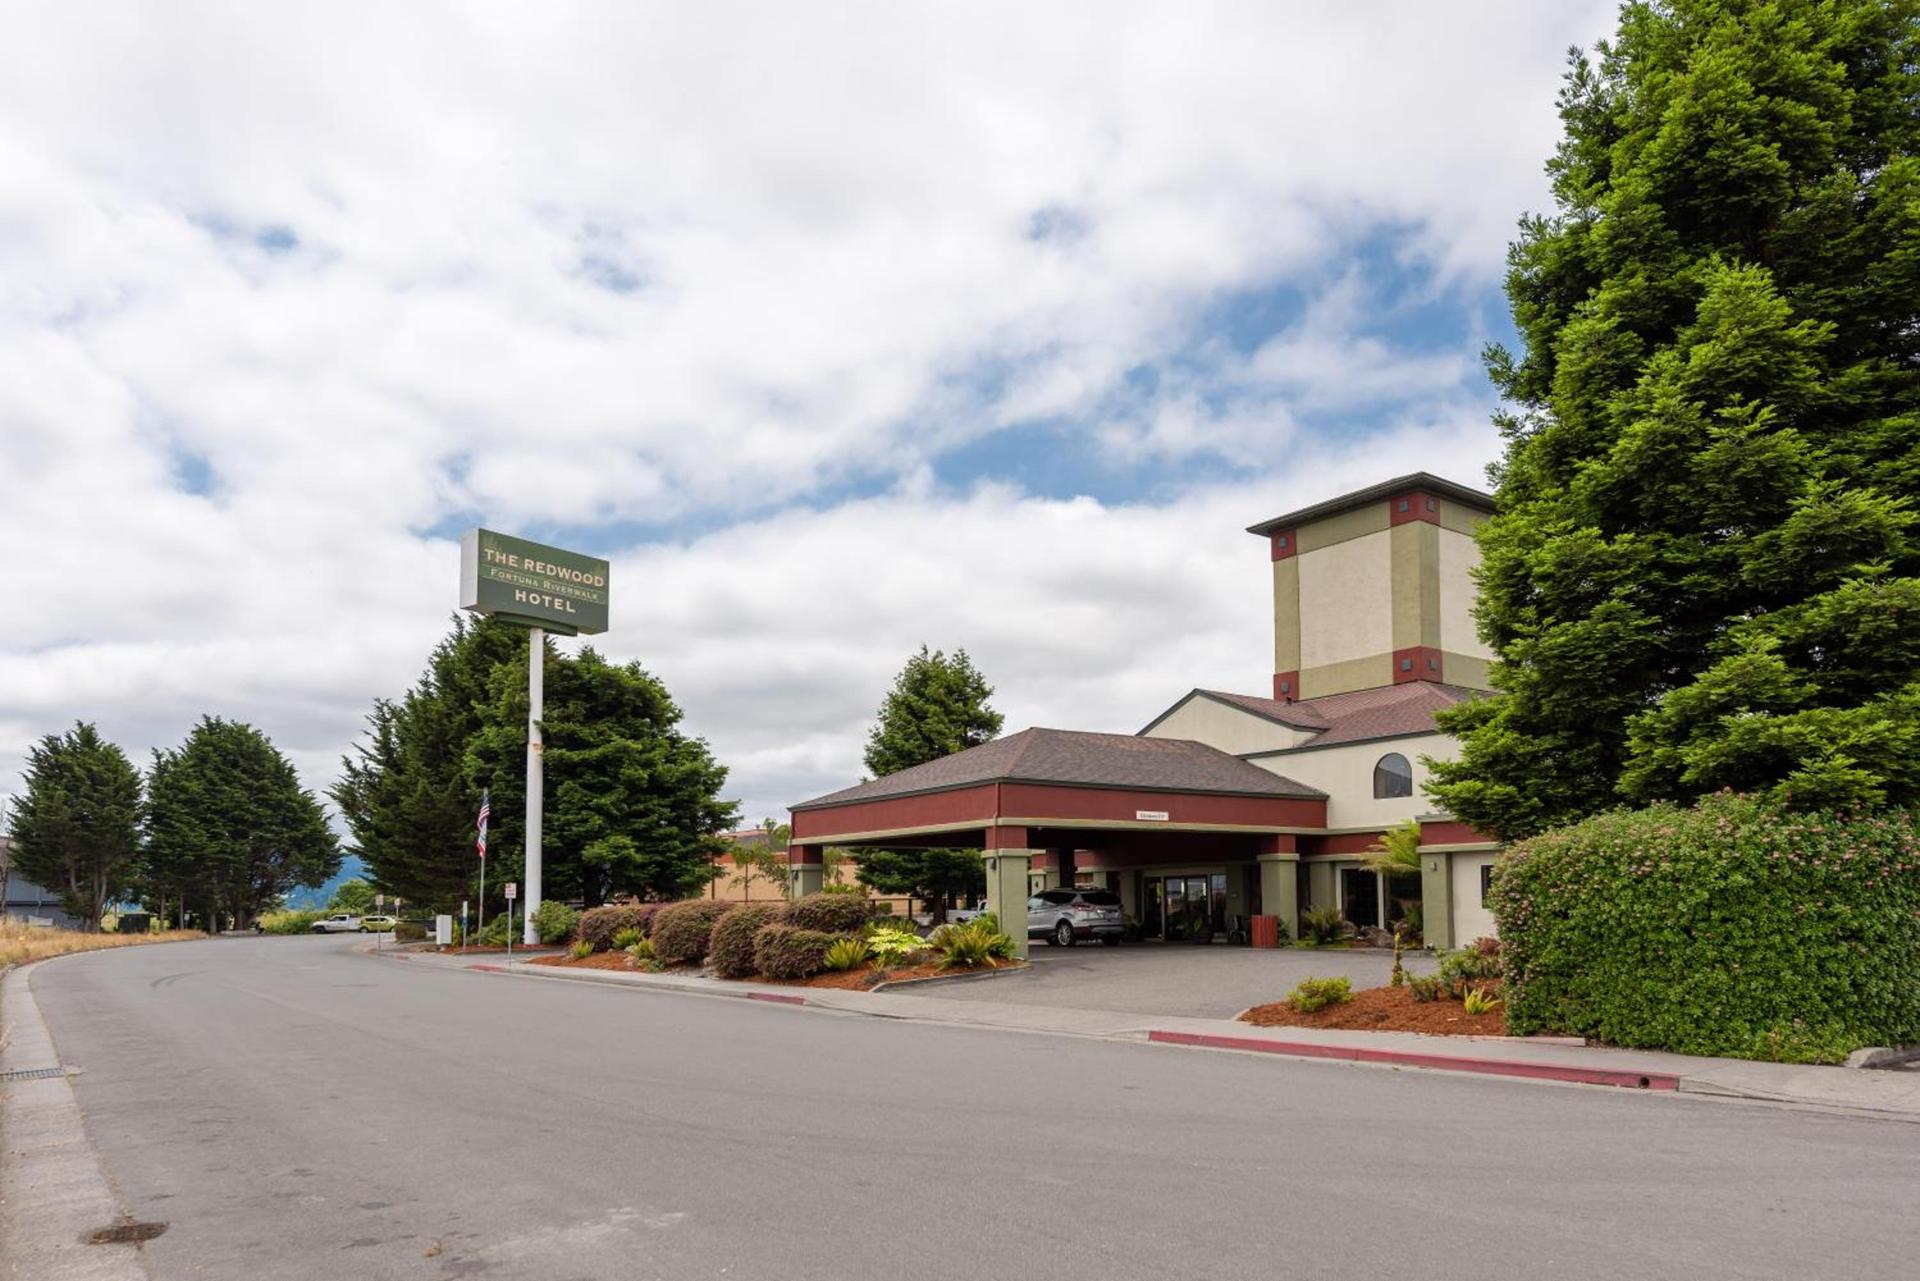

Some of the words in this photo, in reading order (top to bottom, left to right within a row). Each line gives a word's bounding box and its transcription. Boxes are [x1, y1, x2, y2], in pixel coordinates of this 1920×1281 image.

[484, 549, 518, 567] THE
[524, 559, 605, 587] REDWOOD
[515, 589, 576, 613] HOTEL
